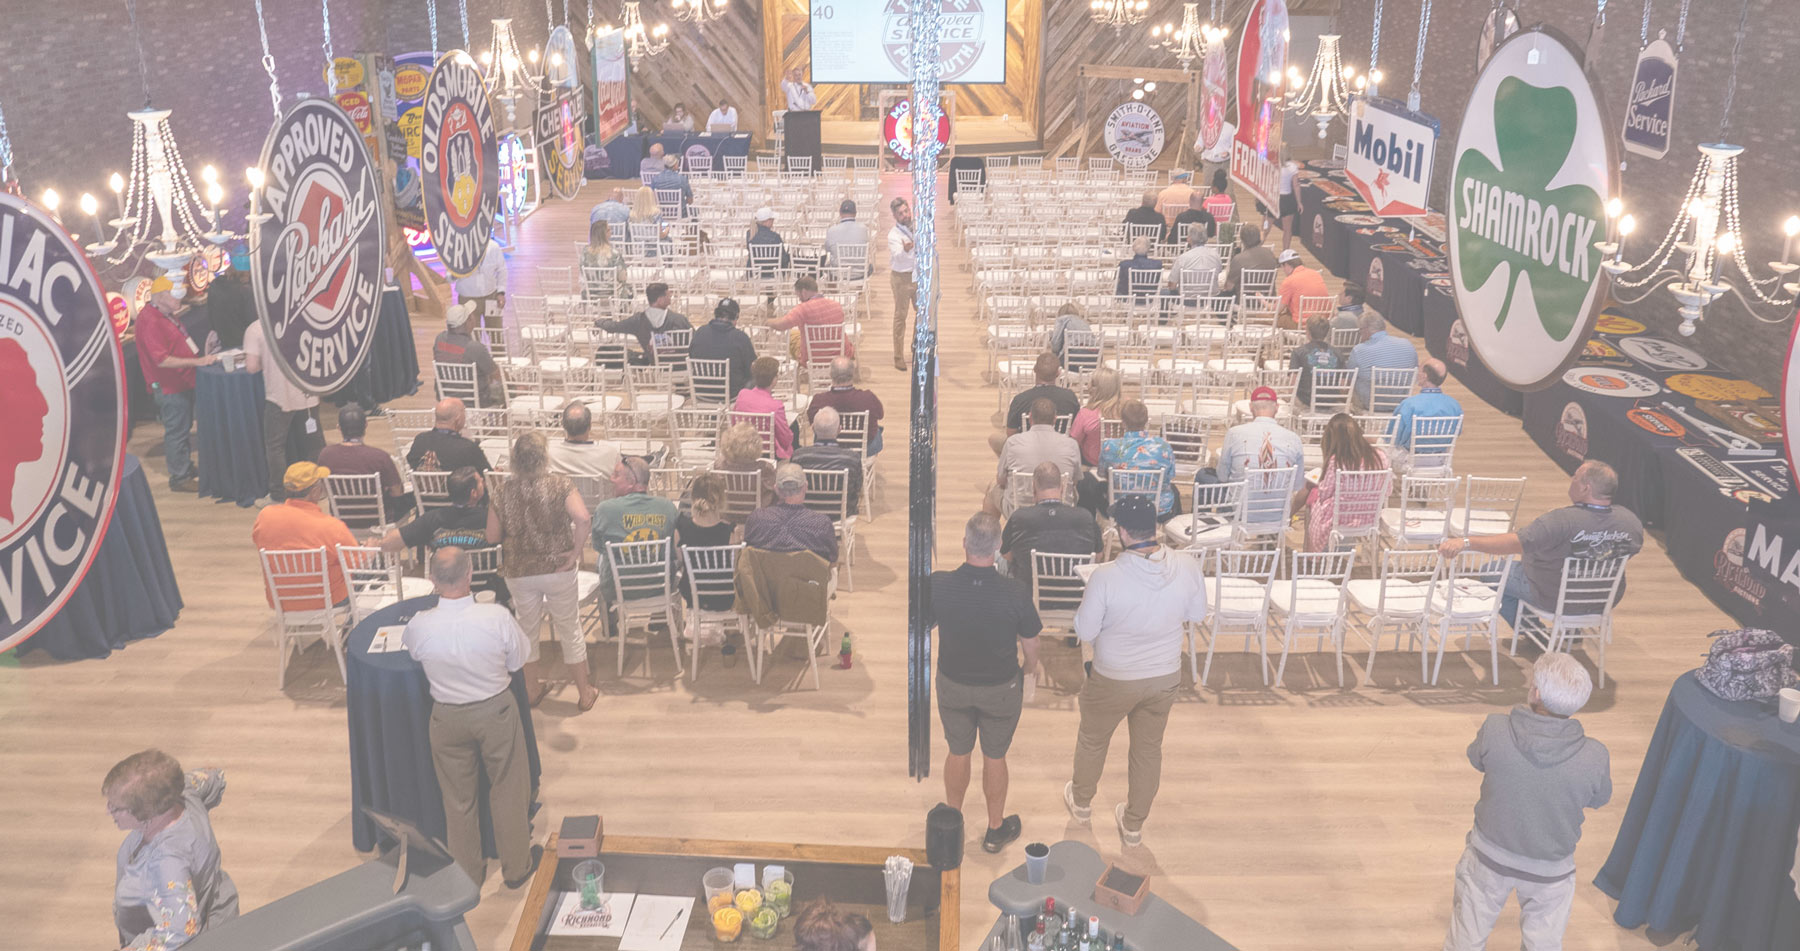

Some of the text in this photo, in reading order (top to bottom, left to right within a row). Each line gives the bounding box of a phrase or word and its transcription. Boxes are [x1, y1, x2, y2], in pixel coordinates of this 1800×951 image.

[813, 5, 834, 20] 40
[423, 63, 494, 174] OLDSMOBILE
[1628, 104, 1668, 136] Service
[1632, 75, 1672, 106] Packard
[265, 113, 353, 222] APPROVED
[1352, 119, 1426, 184] Mobil
[267, 164, 375, 338] Packard
[434, 193, 495, 270] SERVICE
[1458, 176, 1598, 284] SHAMROCK
[295, 271, 374, 377] SERVICE
[562, 914, 613, 927] RICHMOND
